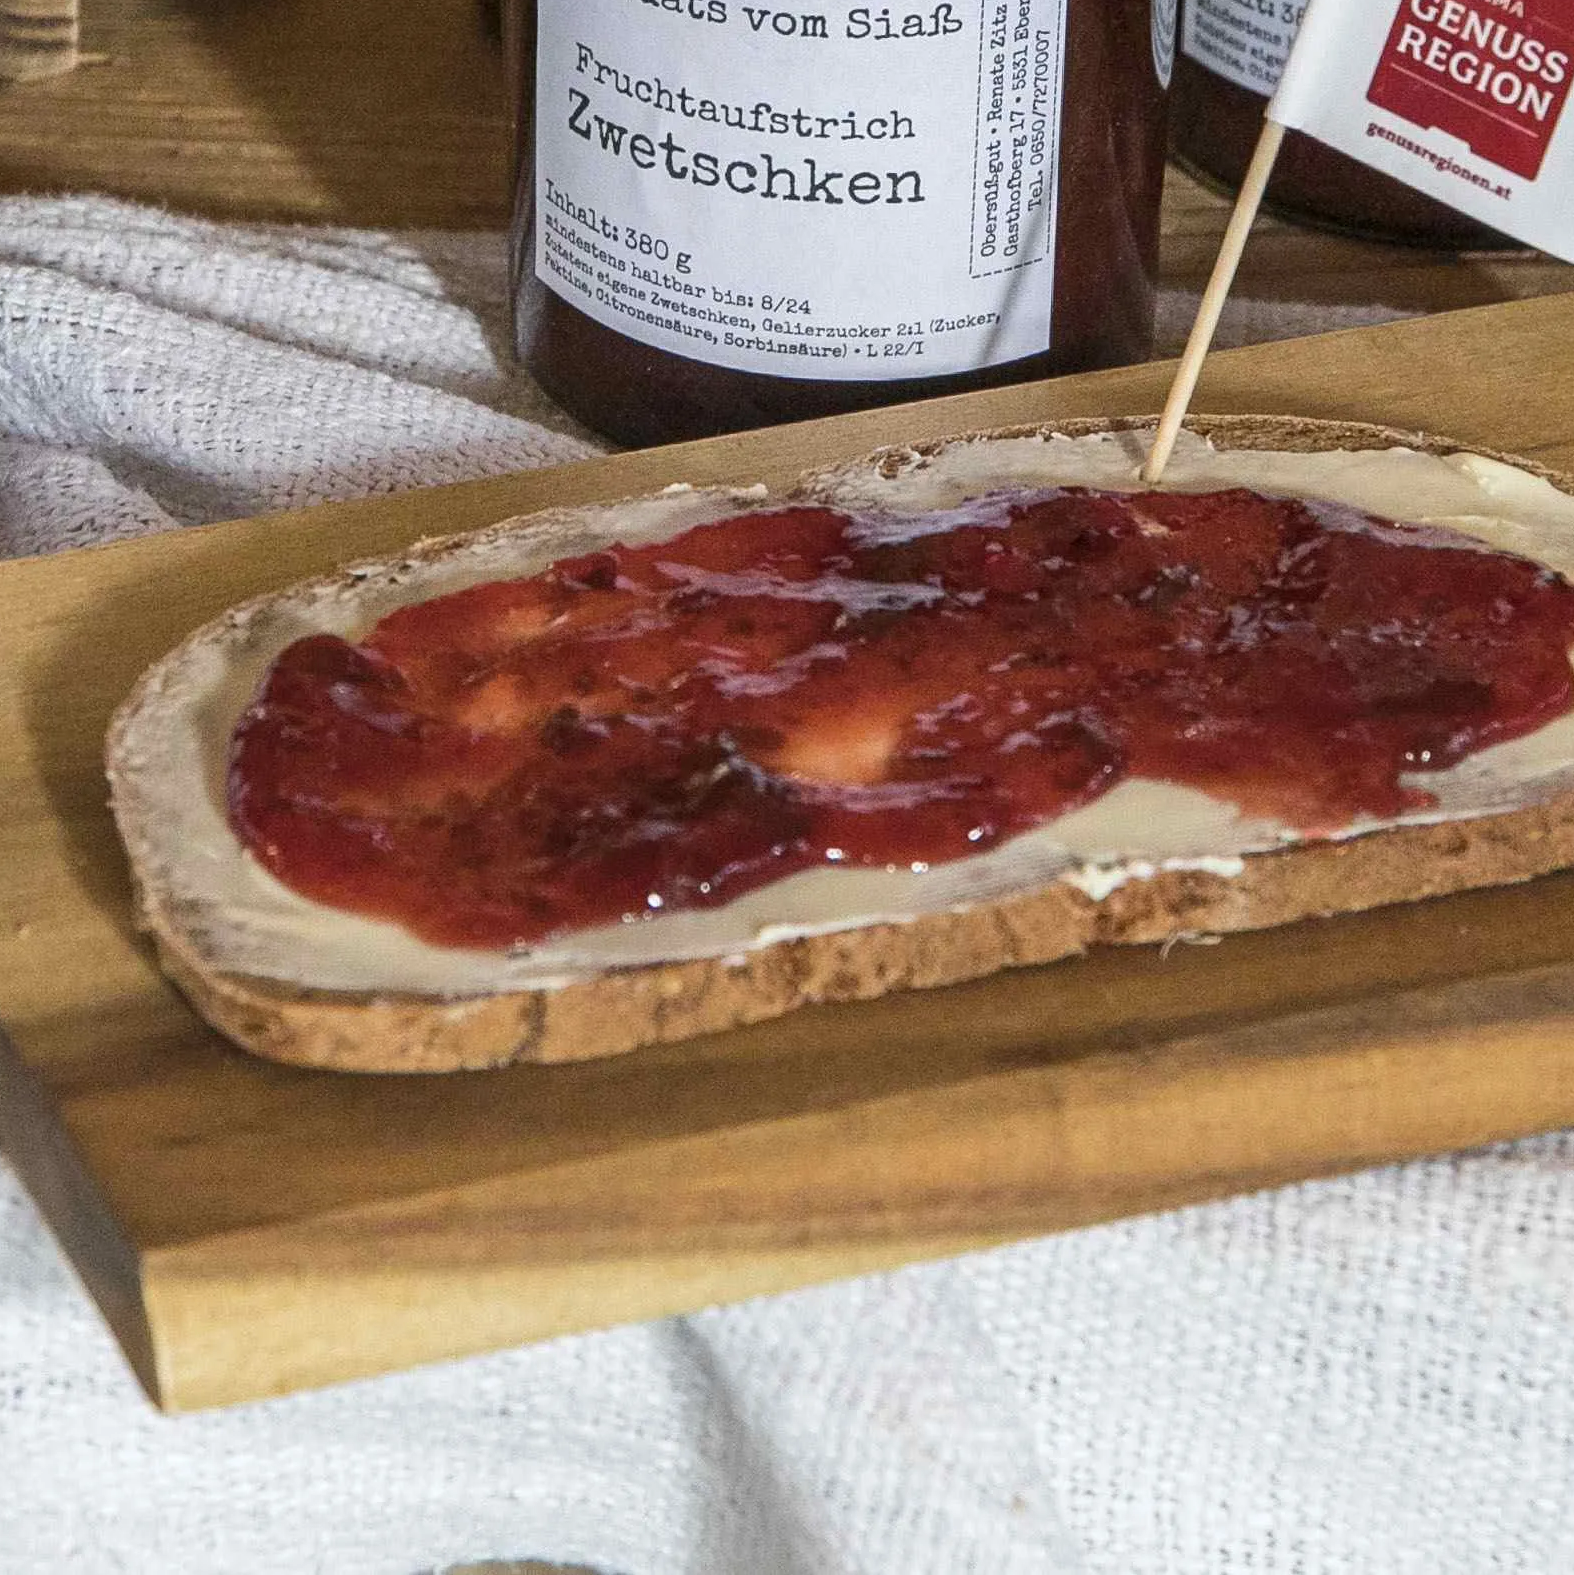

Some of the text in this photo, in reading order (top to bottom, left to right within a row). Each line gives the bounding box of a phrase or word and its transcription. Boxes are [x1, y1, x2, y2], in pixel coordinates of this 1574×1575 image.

[742, 6, 828, 39] vom
[846, 2, 963, 40] Siaß
[990, 3, 1008, 47] Zitz
[574, 41, 915, 141] Fruchtaufstrich
[987, 56, 1005, 122] Renate
[1012, 48, 1030, 95] 5531
[1396, 23, 1555, 121] REGION
[568, 87, 925, 205] Zwetschken
[1010, 109, 1025, 133] 17
[1027, 29, 1051, 213] Tel. 0650/7270007
[1365, 121, 1513, 201] genussregionen.at
[545, 178, 692, 274] Inhalt: 380 g
[1004, 135, 1027, 258] Gasthofberg
[545, 213, 812, 315] mindestens haltbar bis: 8/24
[597, 270, 646, 301] eigene
[651, 291, 756, 332] Zwetschken,
[762, 317, 891, 338] Gelierzucker
[896, 322, 924, 336] 2:1
[929, 311, 1001, 334] (Zucker,
[596, 287, 719, 346] Citronensäure,
[723, 332, 847, 358] Sorbinsäure)
[867, 345, 878, 357] L
[883, 340, 924, 357] 22/I
